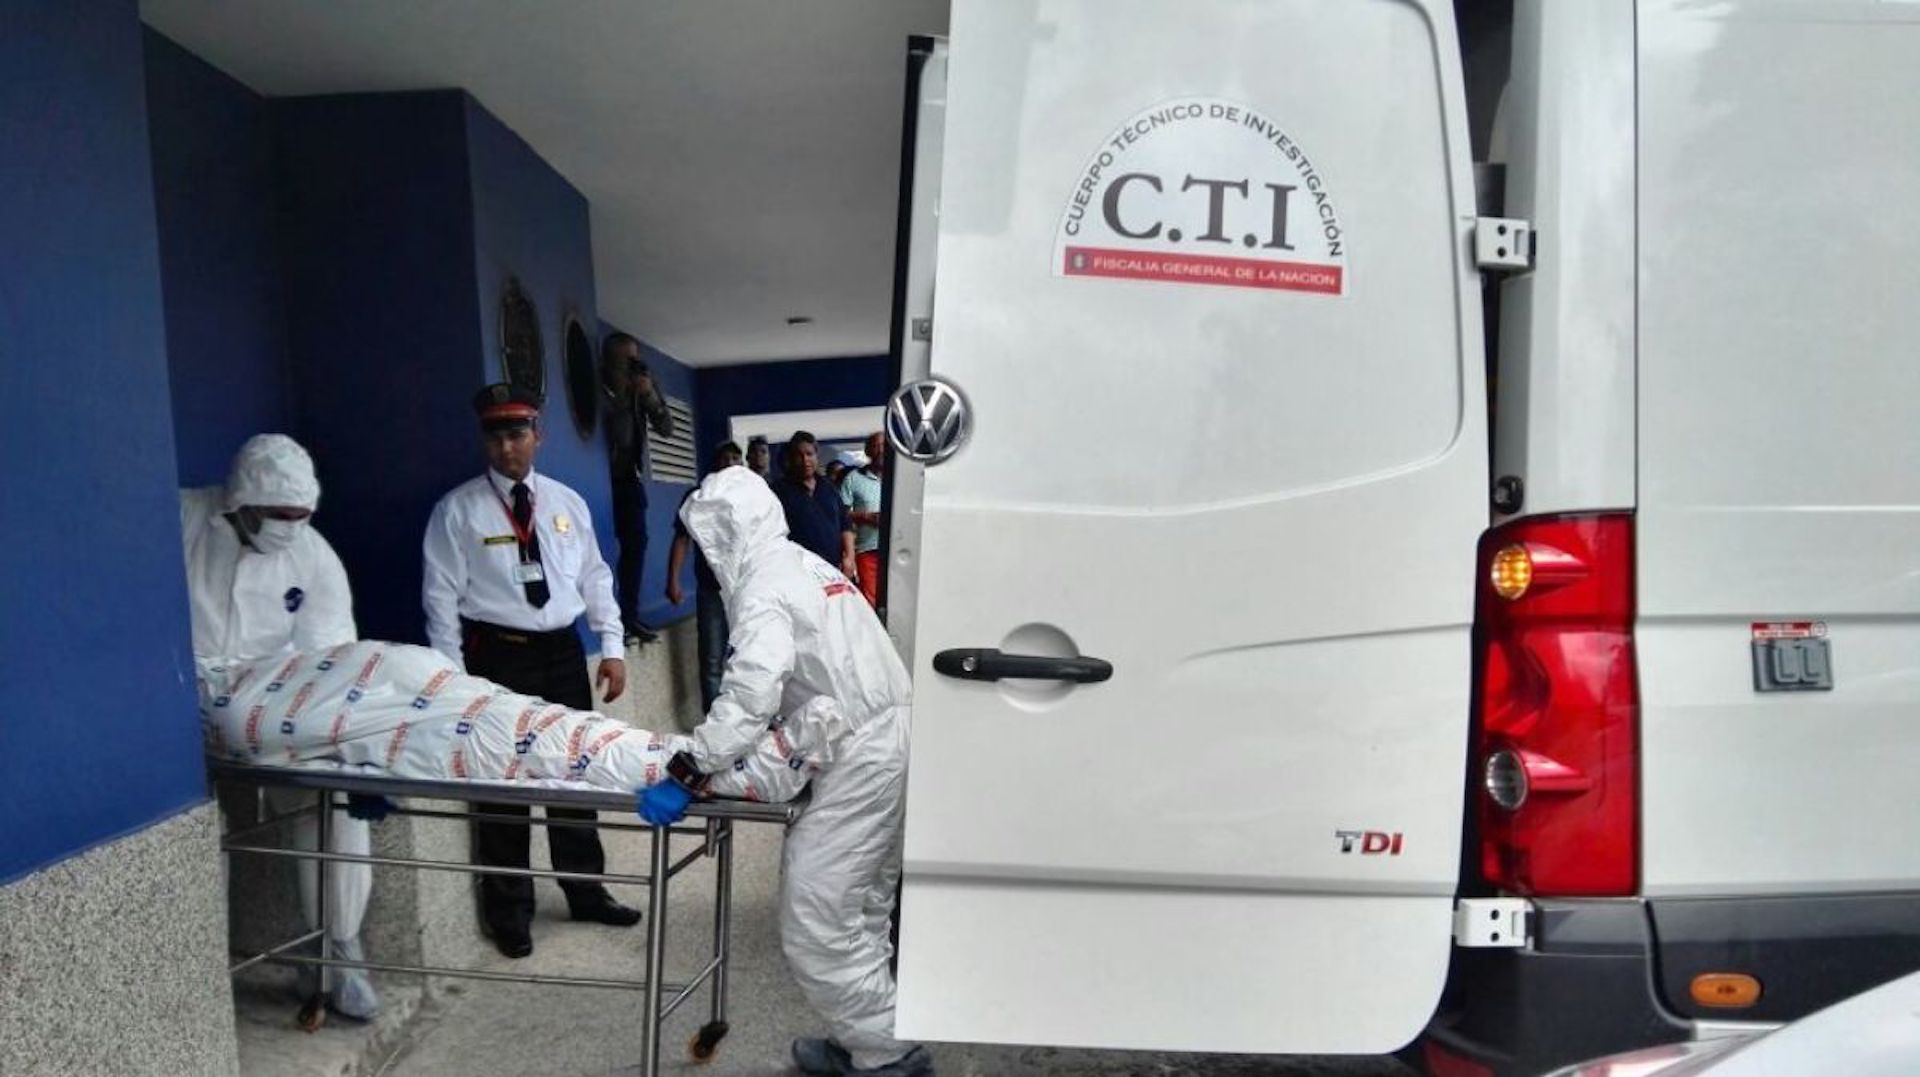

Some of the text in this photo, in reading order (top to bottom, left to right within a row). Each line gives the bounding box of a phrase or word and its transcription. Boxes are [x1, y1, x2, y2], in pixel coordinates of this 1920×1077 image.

[1065, 103, 1343, 257] CUERPO TÉCNICO DE INVESTIGACIÓN
[1102, 172, 1297, 251] C.T.I
[1093, 258, 1161, 273] FISCALIA
[1163, 261, 1231, 278] GENERAL
[1235, 266, 1255, 280] DE
[1258, 269, 1277, 282] LA
[1335, 830, 1404, 856] TDI
